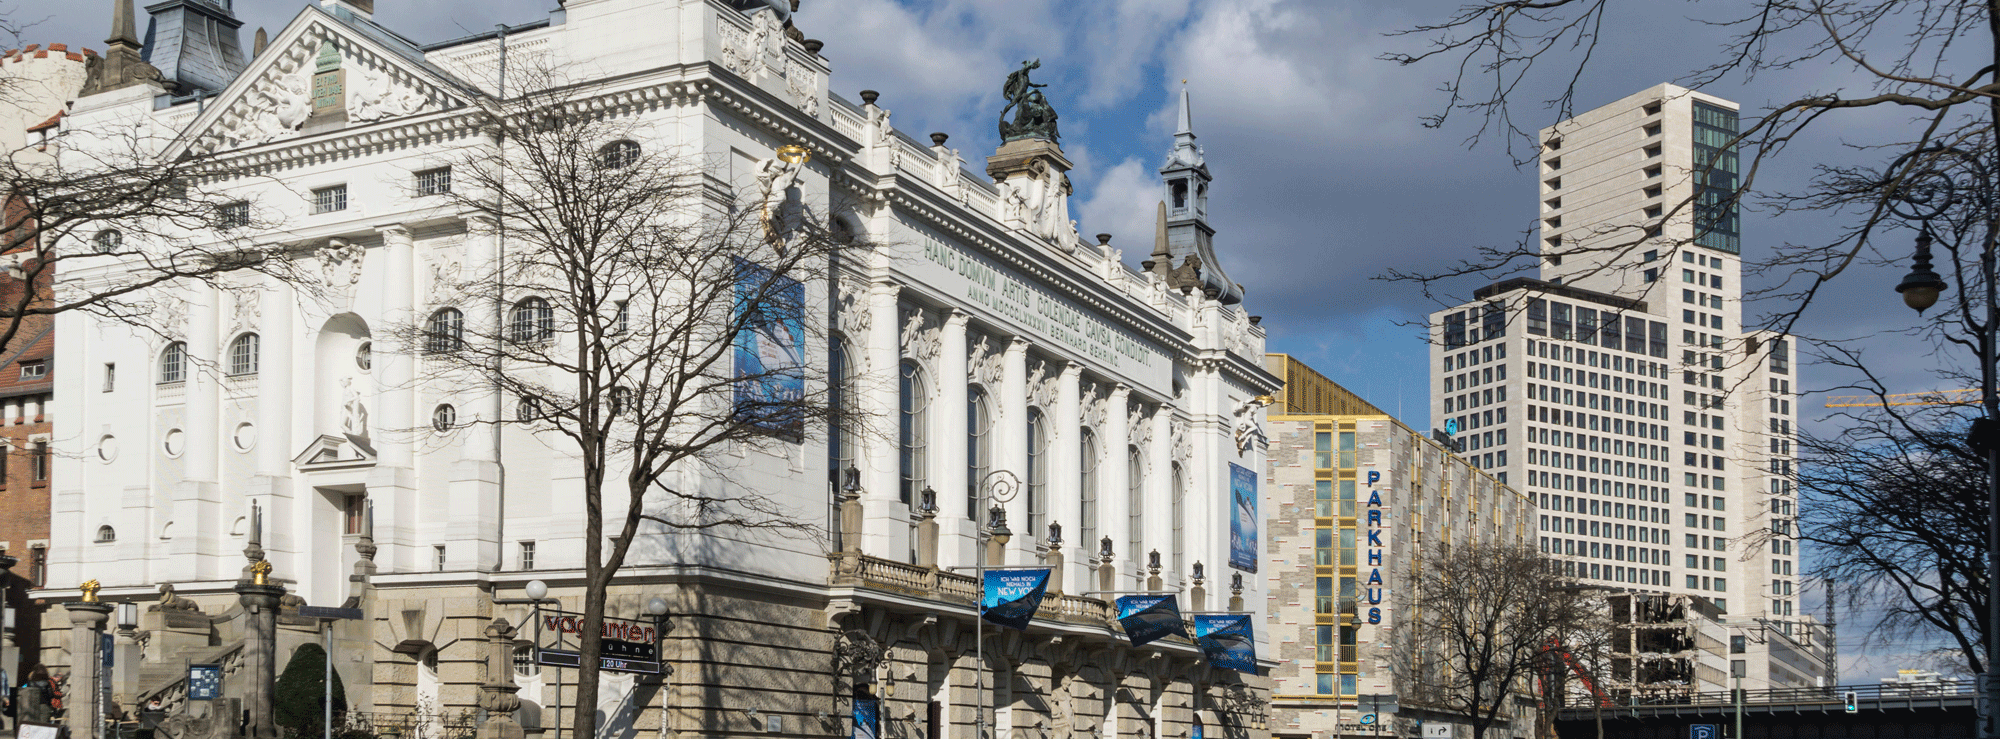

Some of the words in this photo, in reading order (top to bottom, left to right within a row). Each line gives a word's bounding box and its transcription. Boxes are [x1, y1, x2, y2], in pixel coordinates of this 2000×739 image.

[924, 238, 955, 271] HANC
[958, 255, 996, 291] DOMVM
[1002, 278, 1030, 308] ARTIS
[1037, 295, 1080, 333] COLENDAE
[1086, 320, 1111, 348] CAVSA
[967, 285, 989, 306] ANNO
[1050, 323, 1087, 352] BERNHARD
[1367, 471, 1382, 625] PARKHAUS
[997, 586, 1017, 596] NEW
[606, 659, 615, 668] 20
[615, 660, 628, 669] Uhr
[608, 643, 654, 655] ühne
